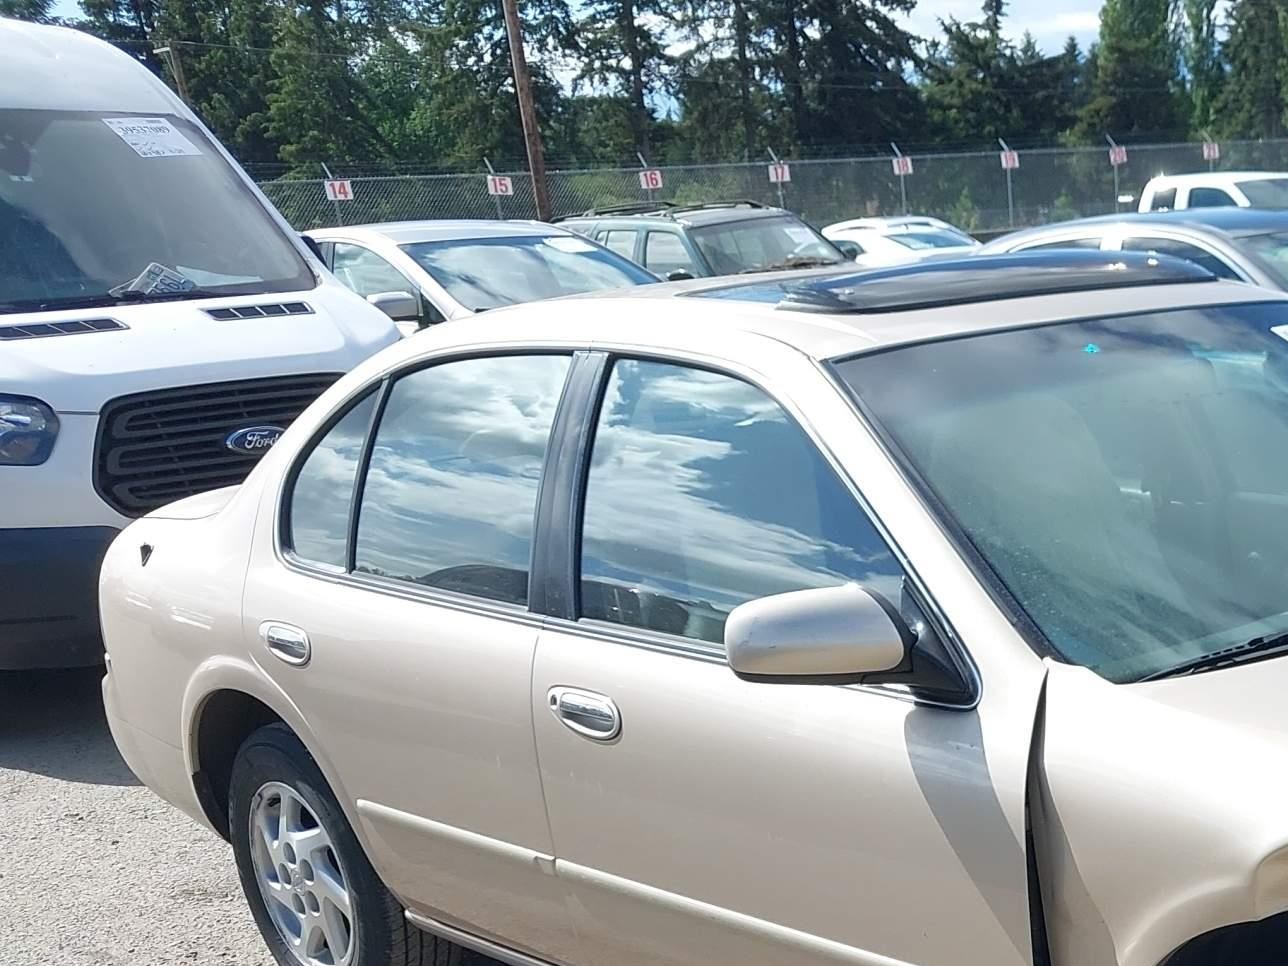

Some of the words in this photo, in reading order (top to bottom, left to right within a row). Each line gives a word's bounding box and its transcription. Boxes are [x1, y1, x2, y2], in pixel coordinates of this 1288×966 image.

[643, 172, 660, 188] 16
[774, 165, 786, 181] 17
[329, 182, 350, 199] 14
[492, 180, 508, 195] 15
[244, 431, 279, 449] Ford
